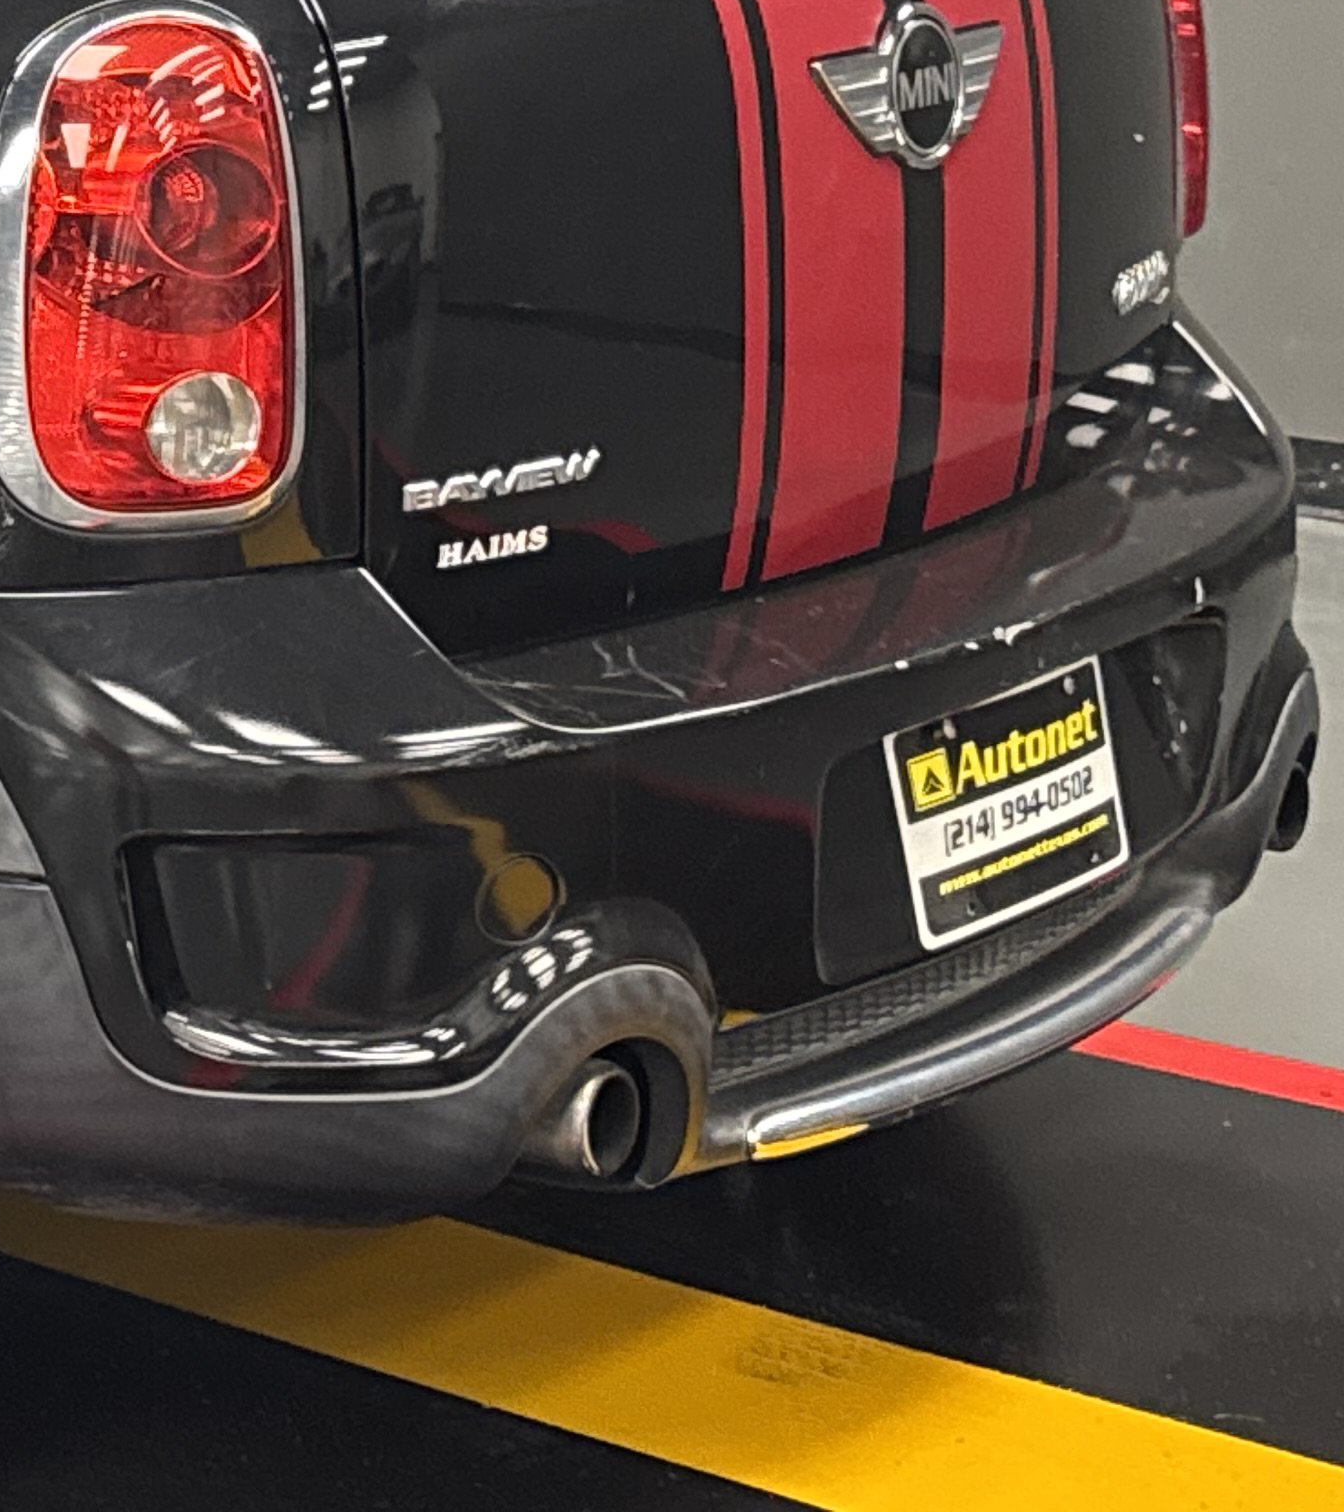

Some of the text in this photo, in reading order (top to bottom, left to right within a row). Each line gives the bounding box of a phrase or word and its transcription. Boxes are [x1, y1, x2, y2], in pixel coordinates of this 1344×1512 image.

[435, 525, 549, 569] HAIMS
[954, 697, 1100, 795] Autonet
[1001, 765, 1095, 832] 994-0502
